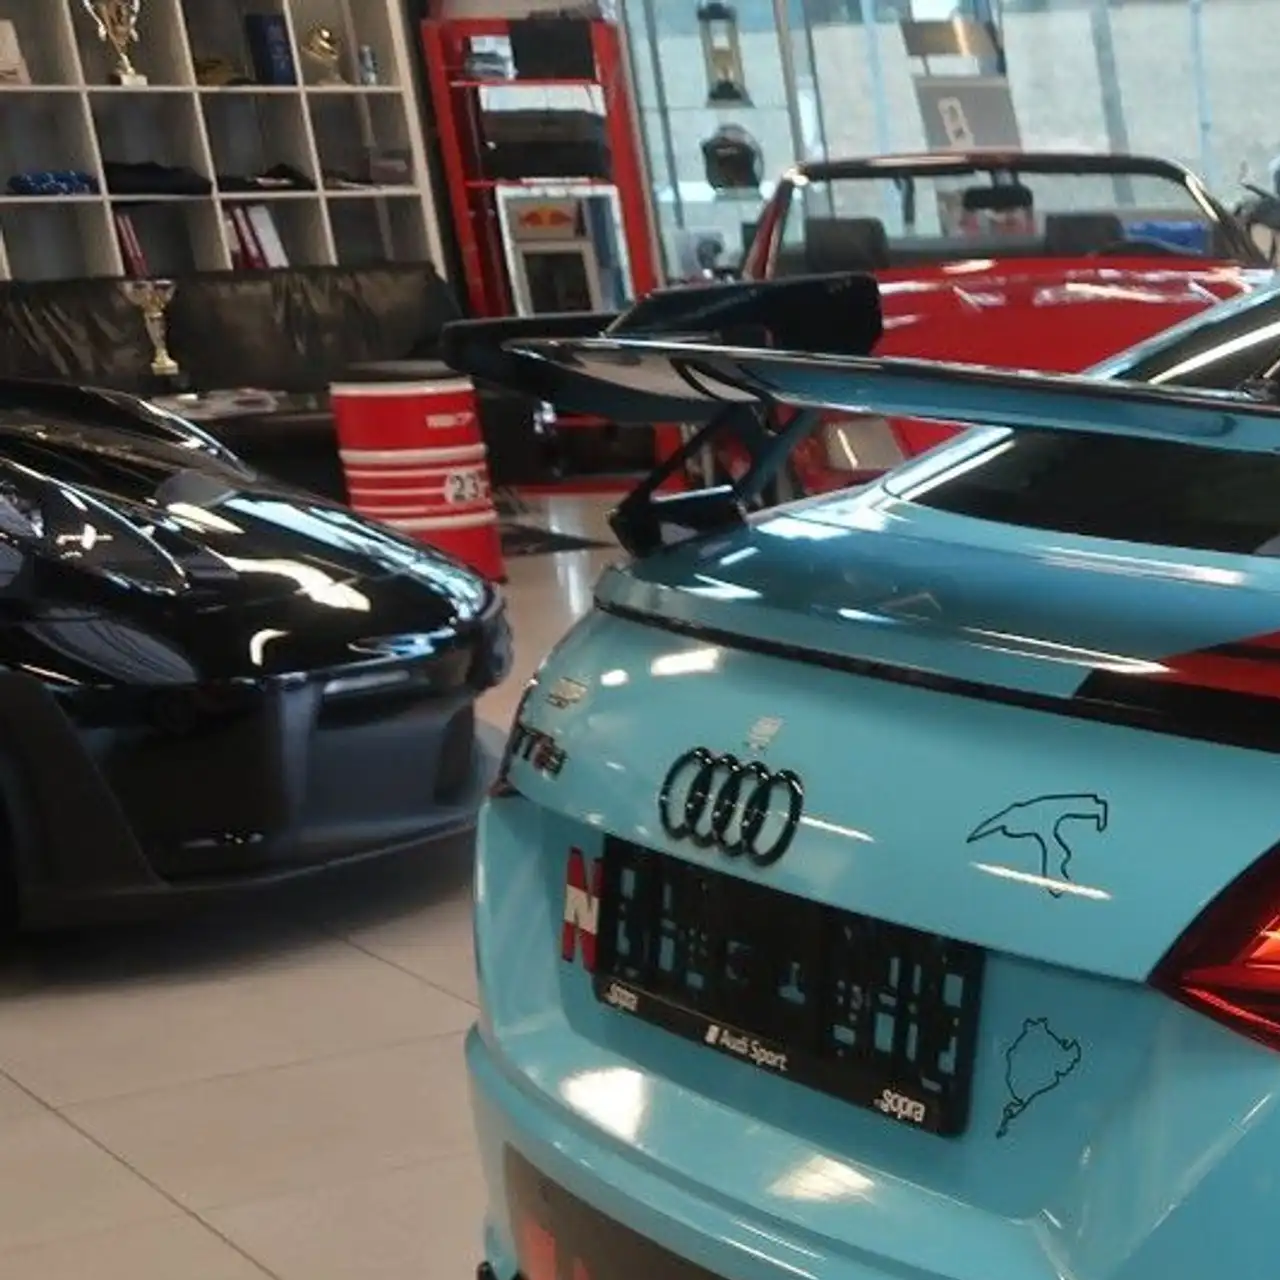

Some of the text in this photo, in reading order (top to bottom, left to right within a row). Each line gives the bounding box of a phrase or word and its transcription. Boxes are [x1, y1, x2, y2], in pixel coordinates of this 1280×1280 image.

[718, 1028, 789, 1072] Audi Sport
[880, 1088, 927, 1123] sopra
